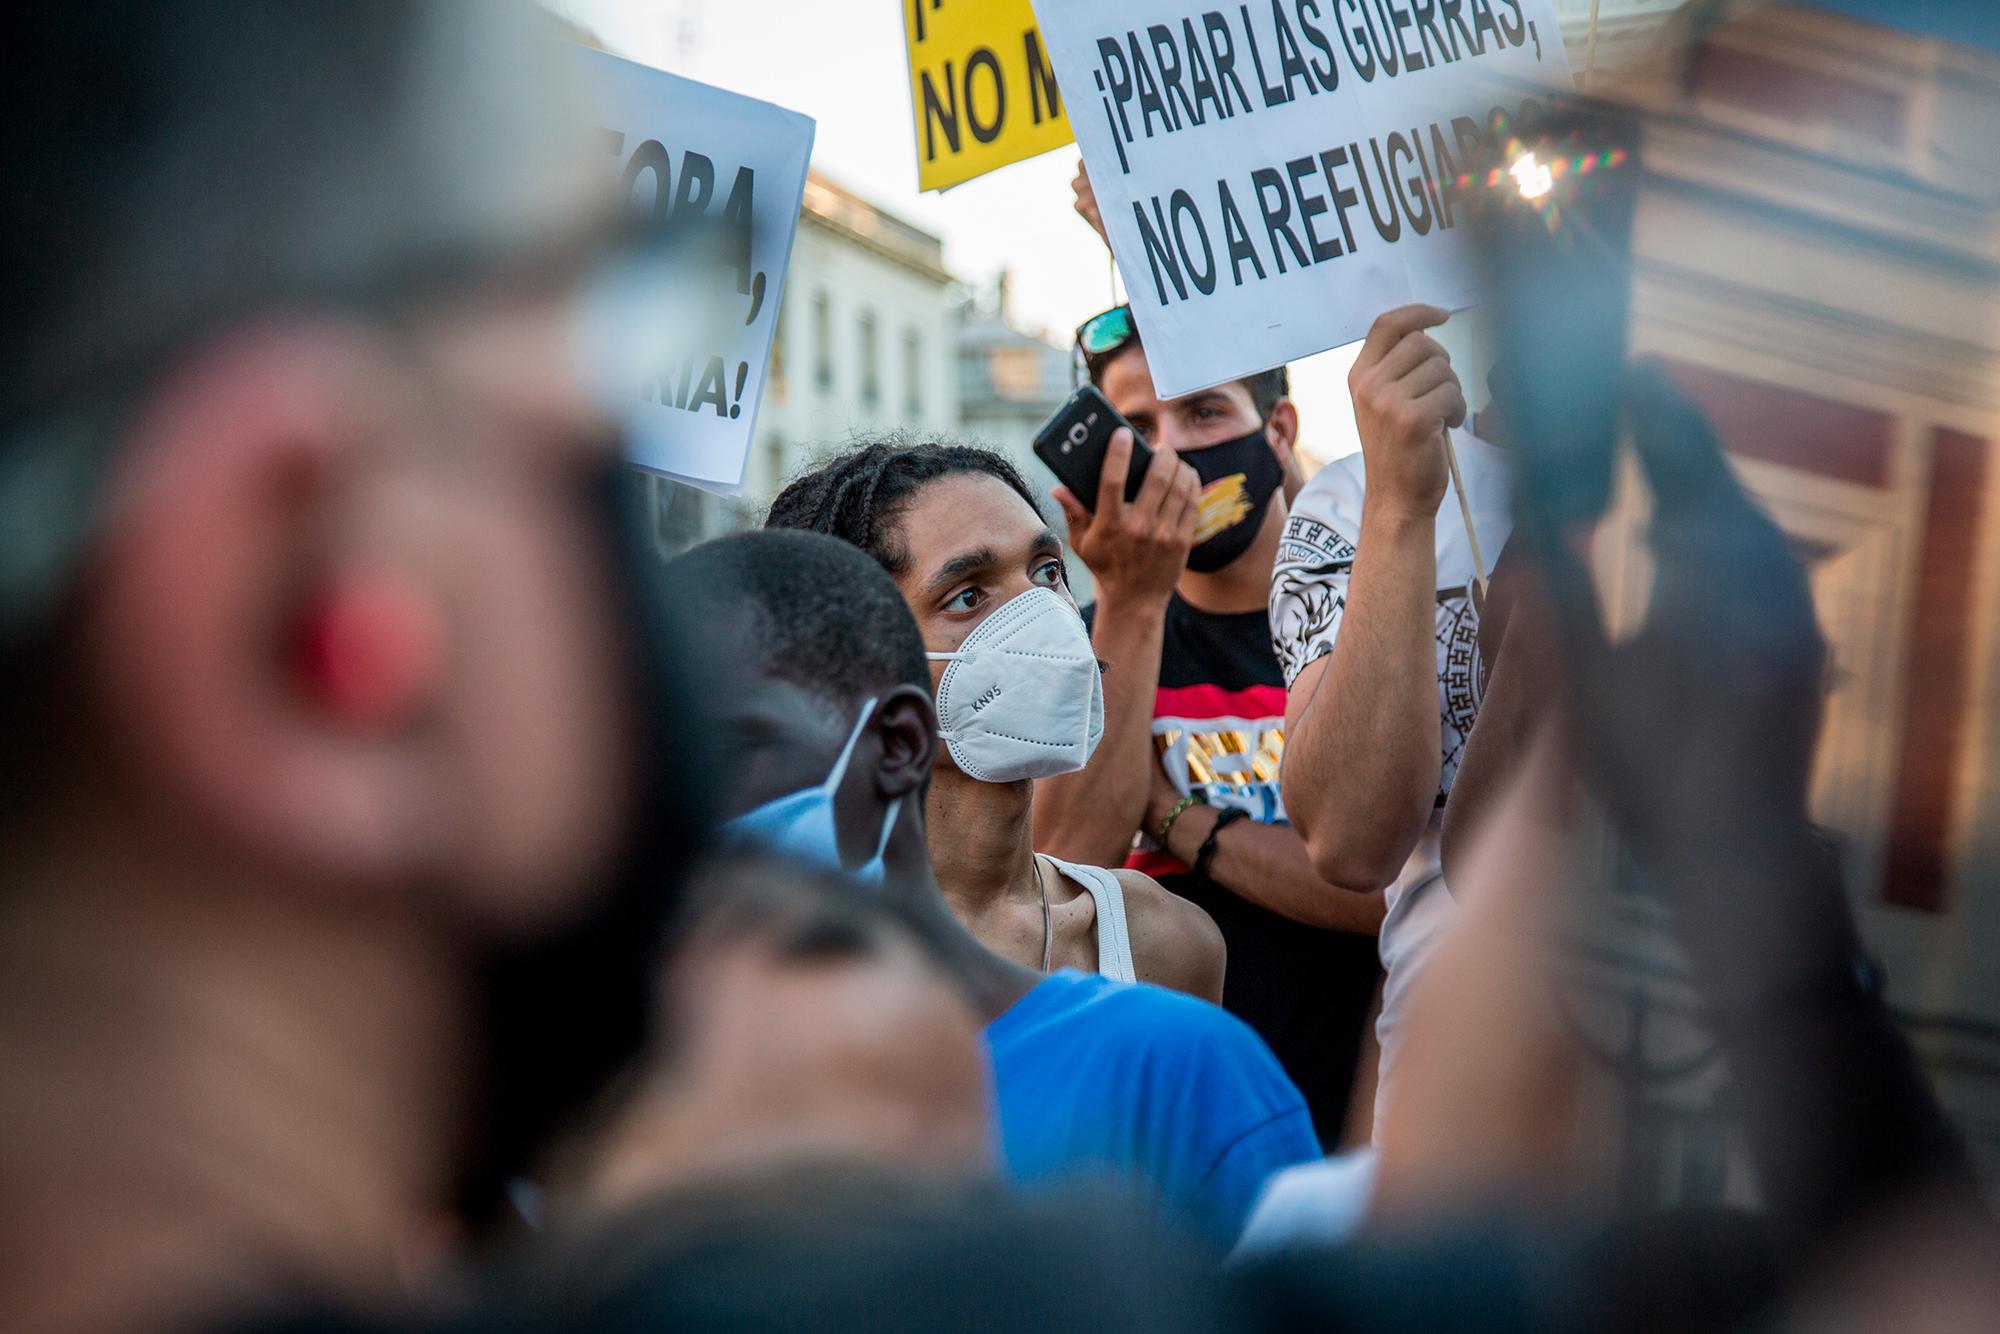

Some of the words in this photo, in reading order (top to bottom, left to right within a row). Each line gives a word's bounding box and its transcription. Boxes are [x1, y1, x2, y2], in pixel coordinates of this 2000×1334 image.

[920, 48, 1006, 162] NO
[1093, 11, 1254, 174] ¡PARAR
[1240, 0, 1340, 108] LAS
[1333, 0, 1542, 83] GUERRAS,
[1132, 188, 1216, 306] NO
[1218, 179, 1267, 286] A
[971, 684, 1003, 713] KN95
